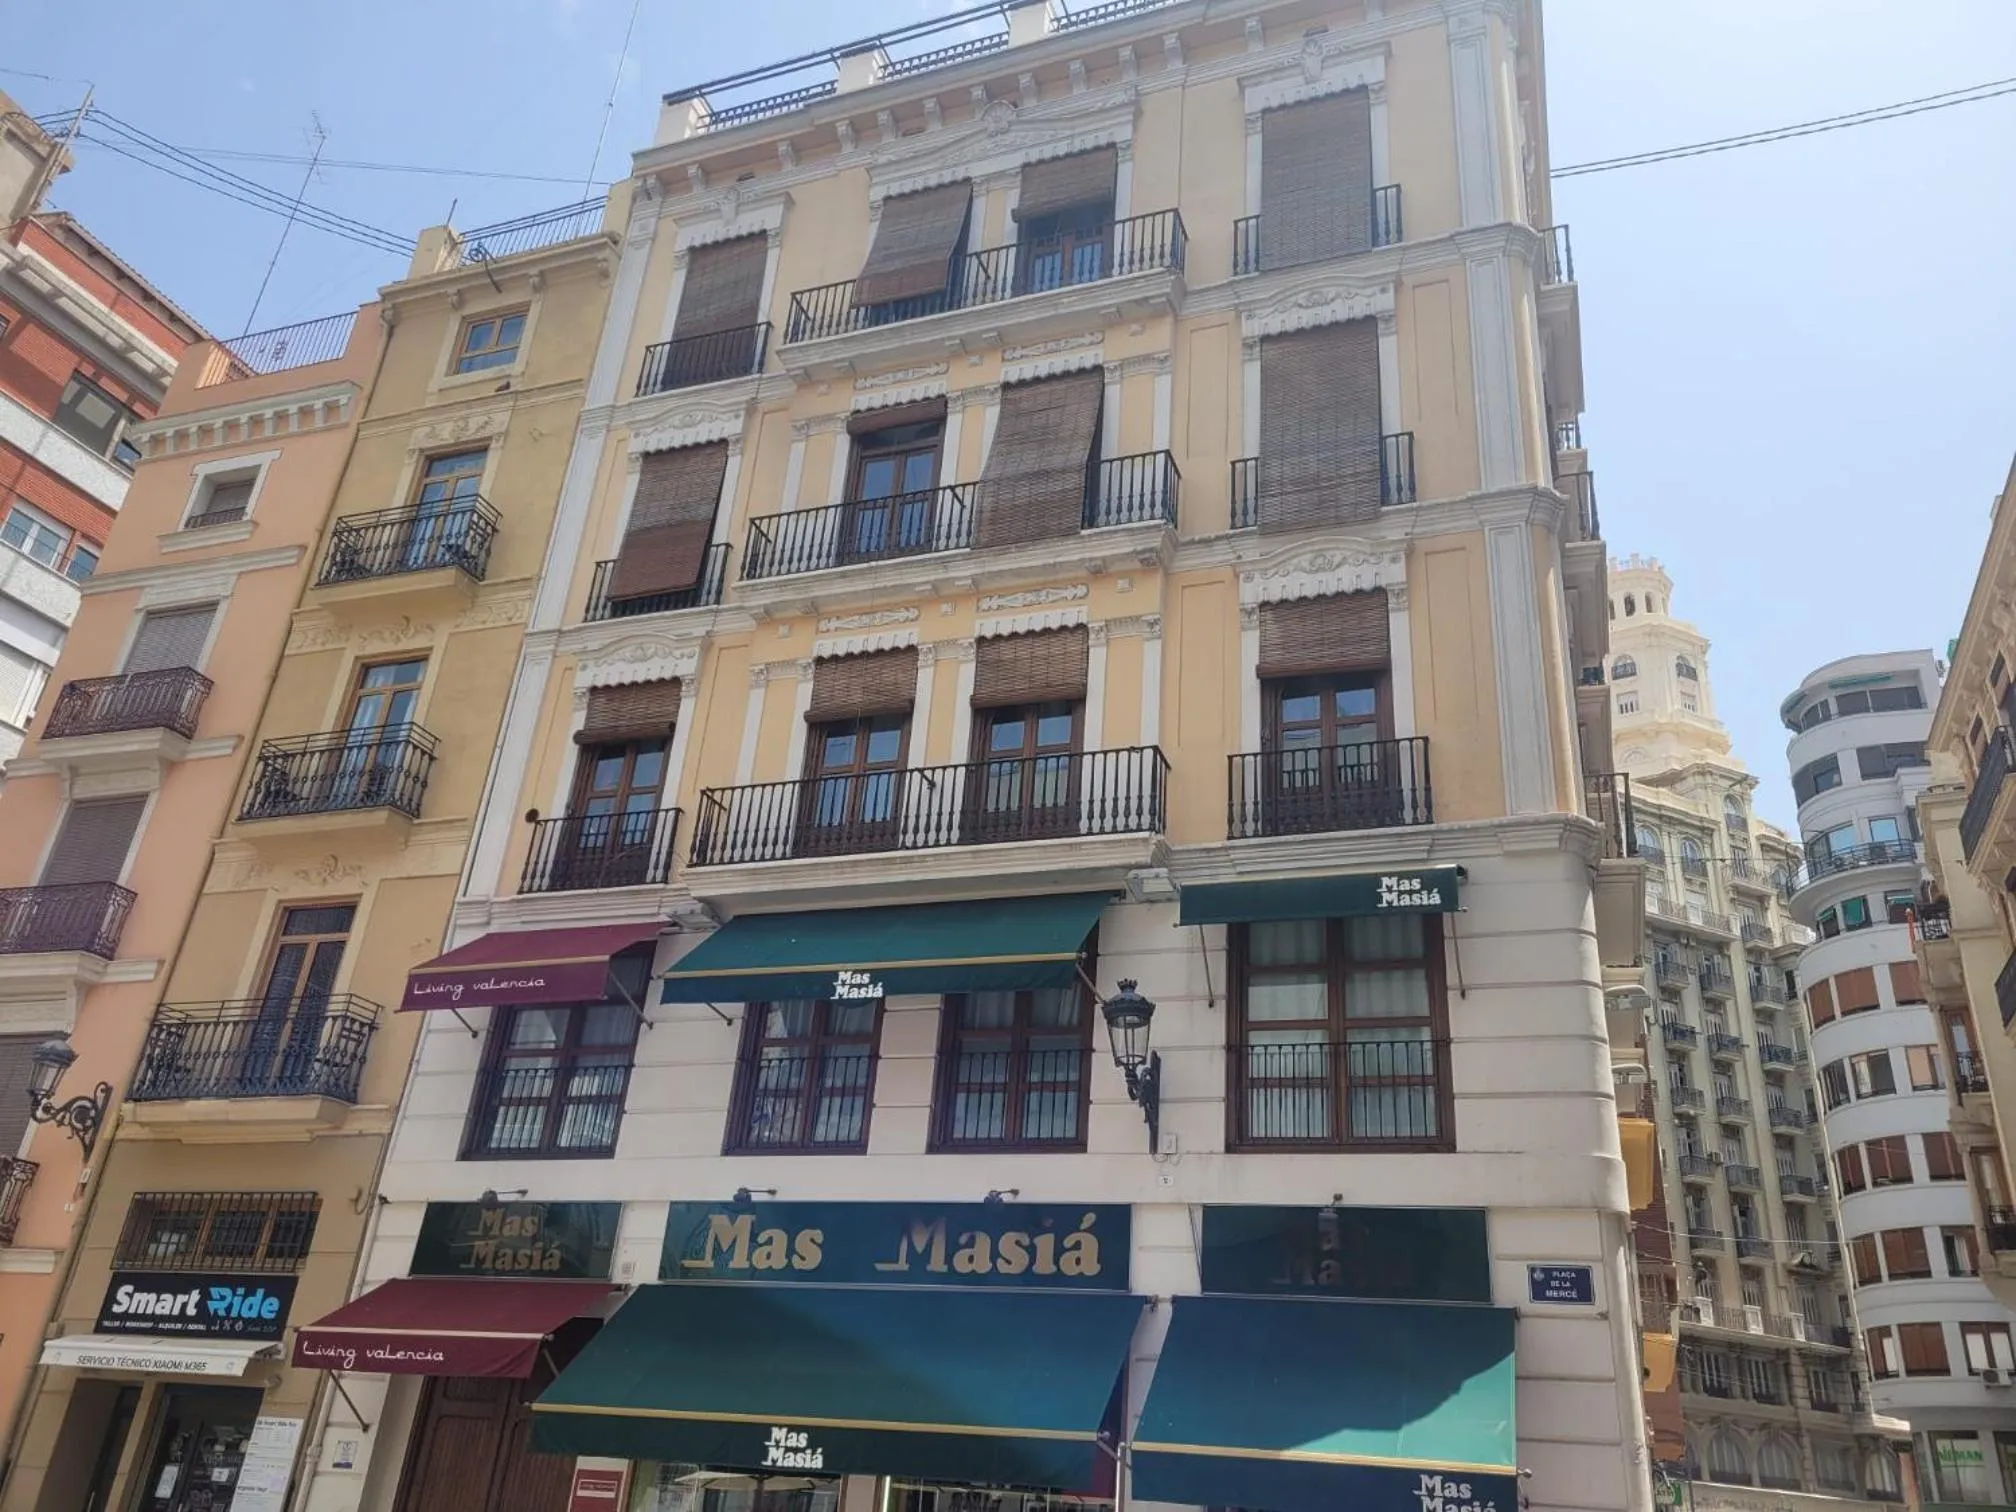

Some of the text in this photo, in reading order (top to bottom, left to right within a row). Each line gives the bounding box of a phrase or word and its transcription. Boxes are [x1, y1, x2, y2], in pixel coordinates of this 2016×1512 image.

[1376, 876, 1421, 892] Mas
[1376, 888, 1442, 907] Masiá
[833, 971, 871, 985] Mas
[413, 981, 464, 1001] Living
[829, 982, 884, 1000] Masiá
[466, 1206, 540, 1238] Mas
[459, 1239, 563, 1272] Masiá
[681, 1212, 1101, 1277] Mas Masiá
[1552, 1271, 1576, 1279] PLAÇA
[112, 1284, 280, 1320] Smart Ride
[79, 1355, 115, 1366] SERVICIO
[117, 1356, 151, 1368] TÉCNICO
[152, 1359, 183, 1370] XIAOMI
[303, 1341, 356, 1369] Living
[764, 1426, 809, 1448] Mas
[761, 1447, 824, 1469] Masiá
[1411, 1473, 1473, 1499] Mas
